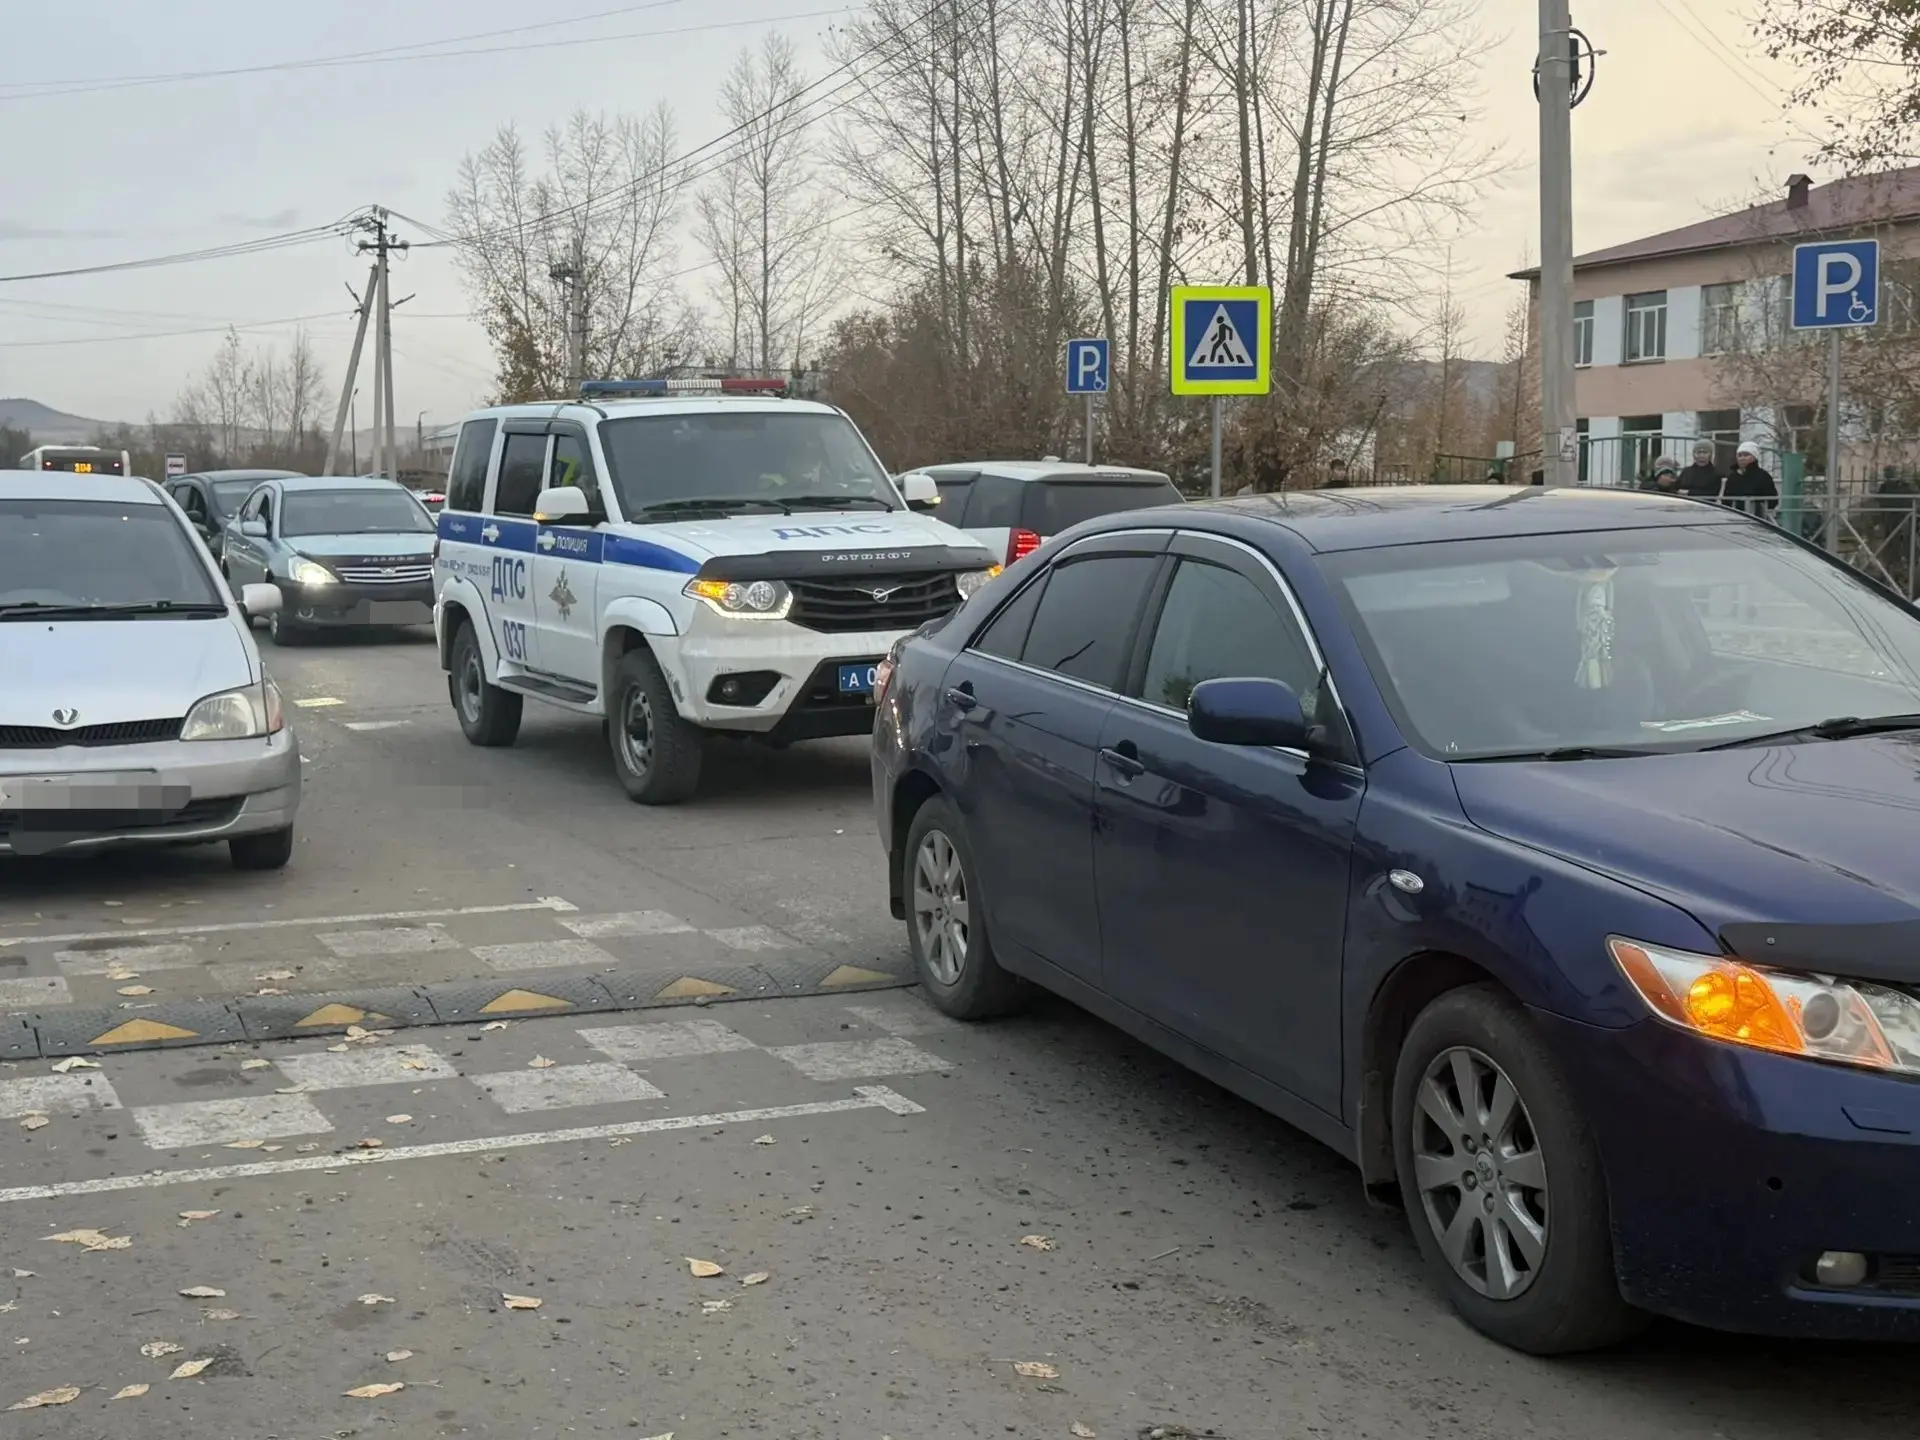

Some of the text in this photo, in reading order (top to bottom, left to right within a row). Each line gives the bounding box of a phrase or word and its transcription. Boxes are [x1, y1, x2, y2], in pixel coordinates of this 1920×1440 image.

[1816, 252, 1862, 317] P
[1078, 345, 1100, 387] P
[556, 535, 588, 553] ПОЛИЦИЯ
[771, 525, 892, 540] ДПС
[491, 556, 525, 604] ДПС
[503, 620, 527, 661] 037
